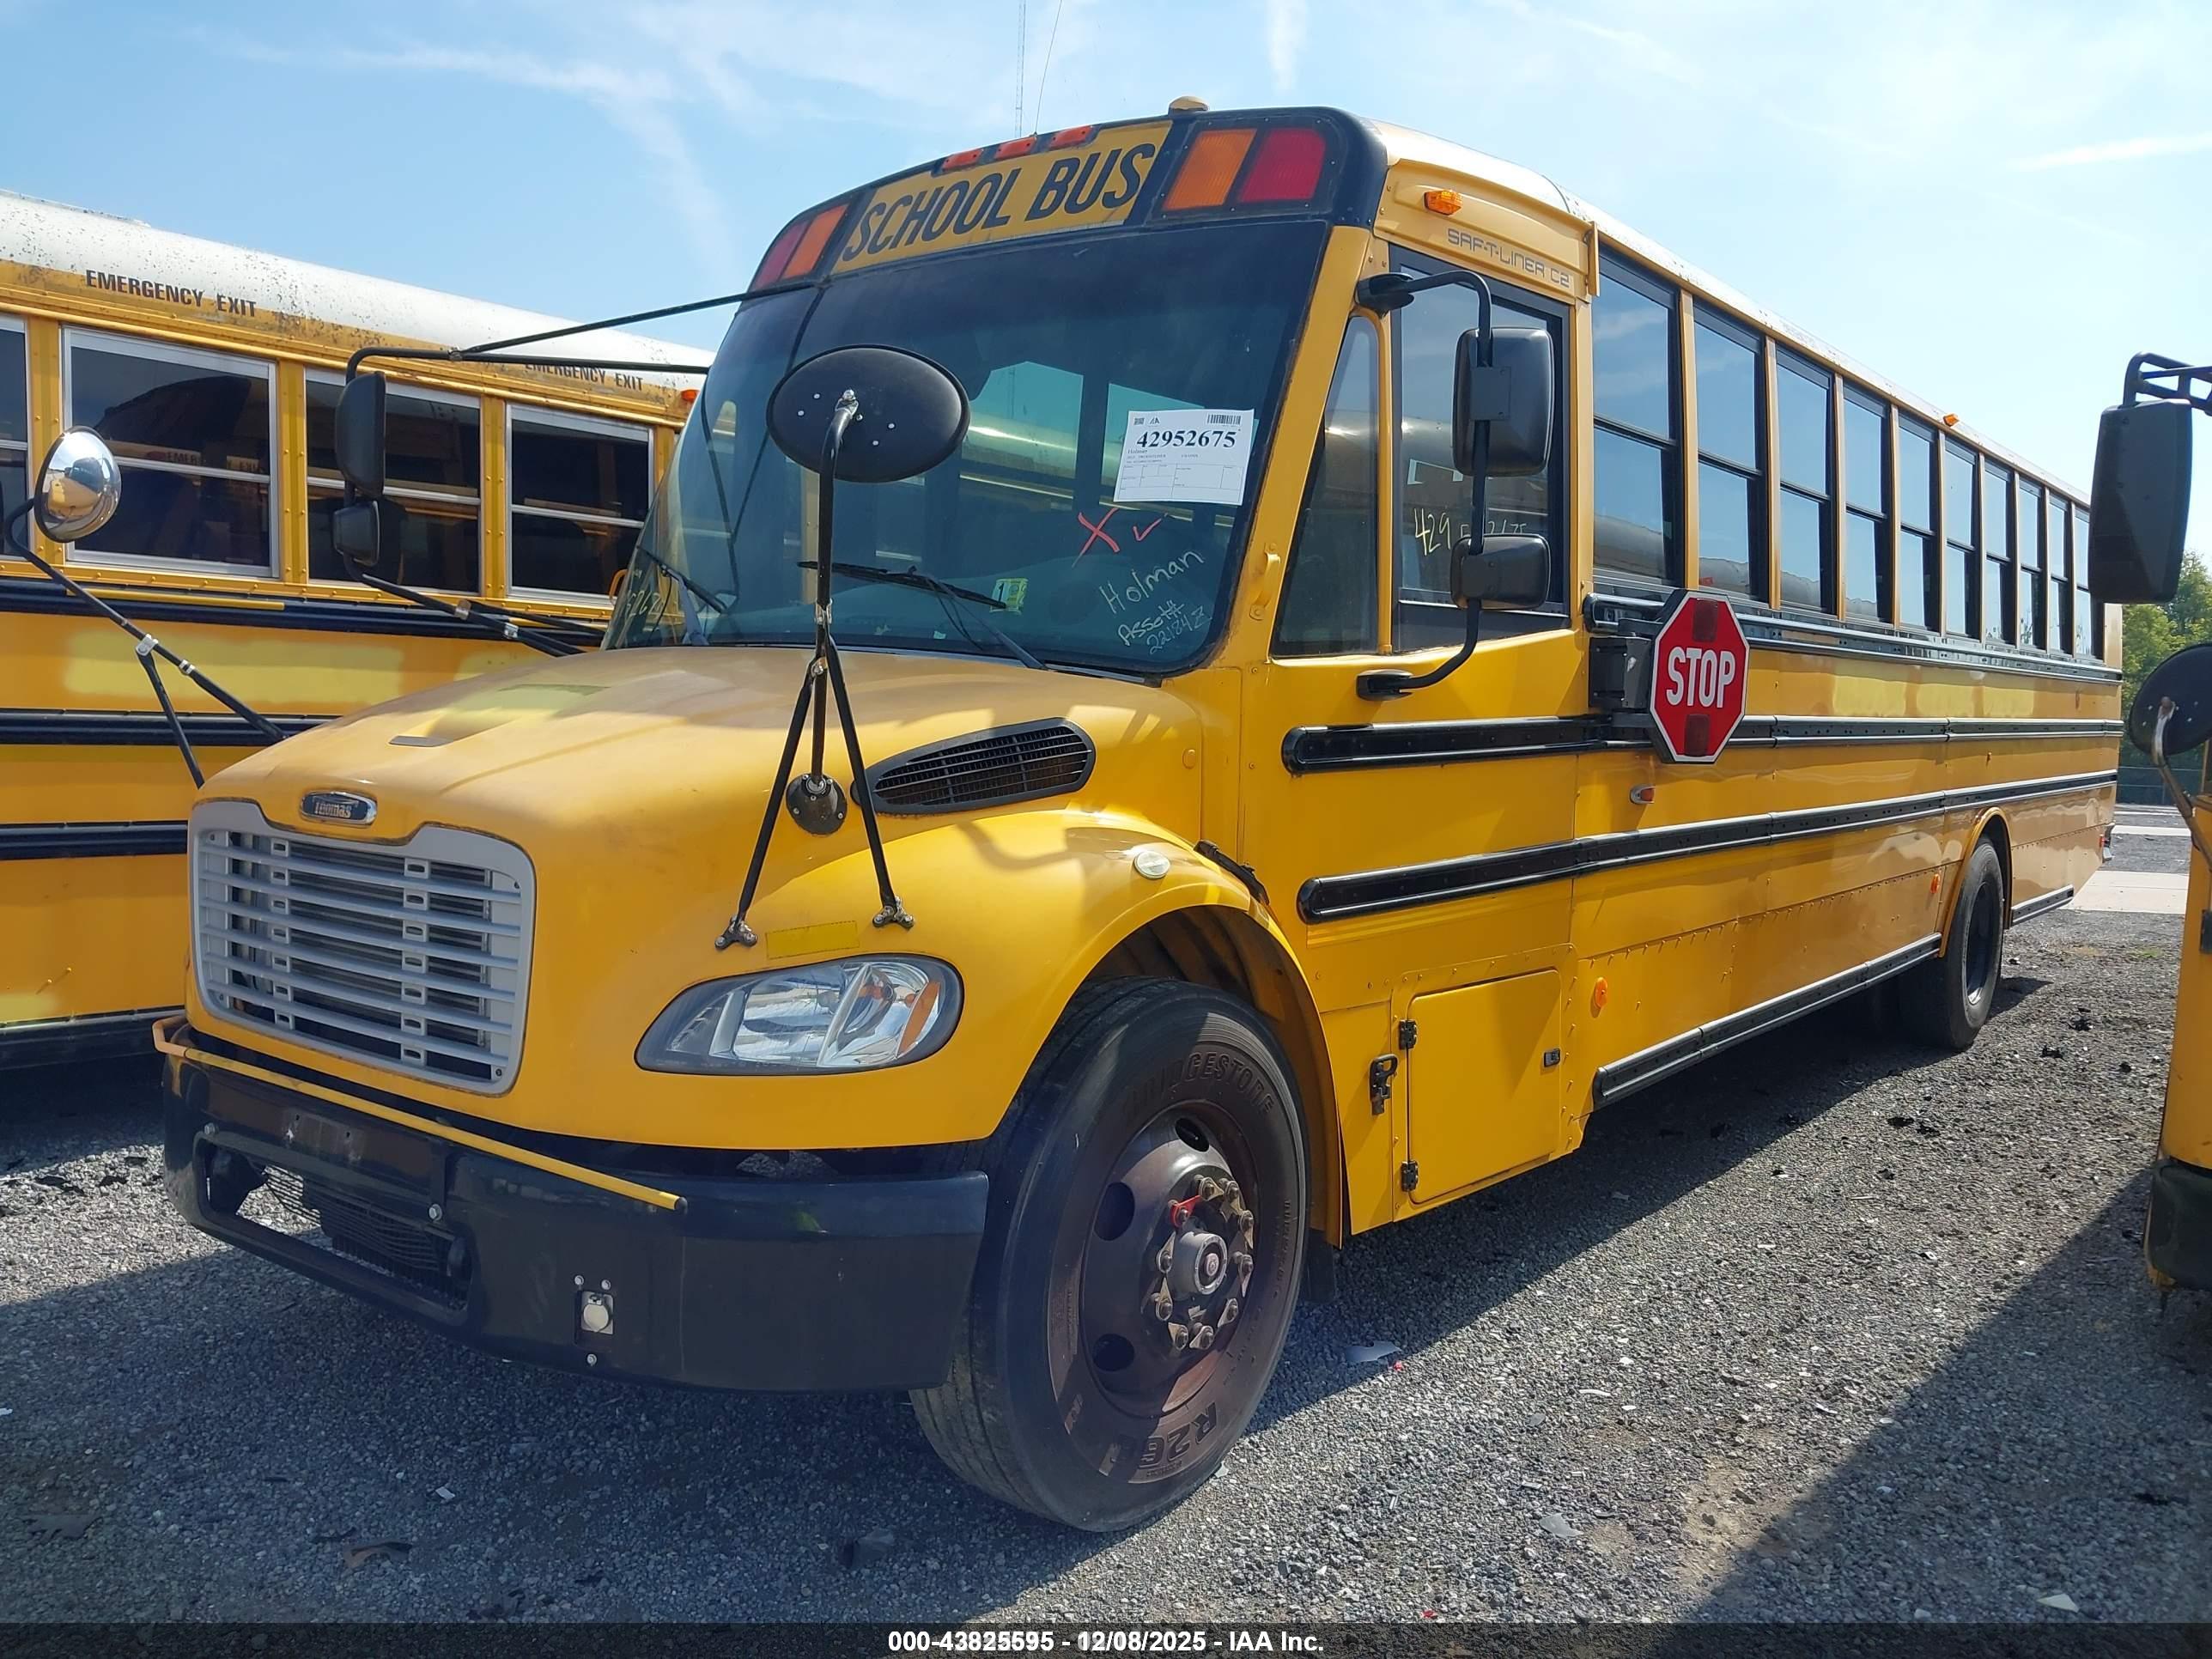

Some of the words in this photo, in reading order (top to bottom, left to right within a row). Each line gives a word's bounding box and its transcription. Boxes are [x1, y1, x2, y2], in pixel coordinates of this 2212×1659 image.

[842, 167, 1023, 262] SCHOOL
[1024, 143, 1156, 222] BUS
[1448, 228, 1545, 279] SAF-T-LINER
[1550, 267, 1571, 289] C2
[86, 269, 204, 307] EMERGENCY
[216, 293, 257, 318] EXIT
[615, 373, 644, 392] EXIT
[1136, 430, 1237, 448] 42952675
[1099, 550, 1205, 614] Holman
[1666, 646, 1736, 708] STOP
